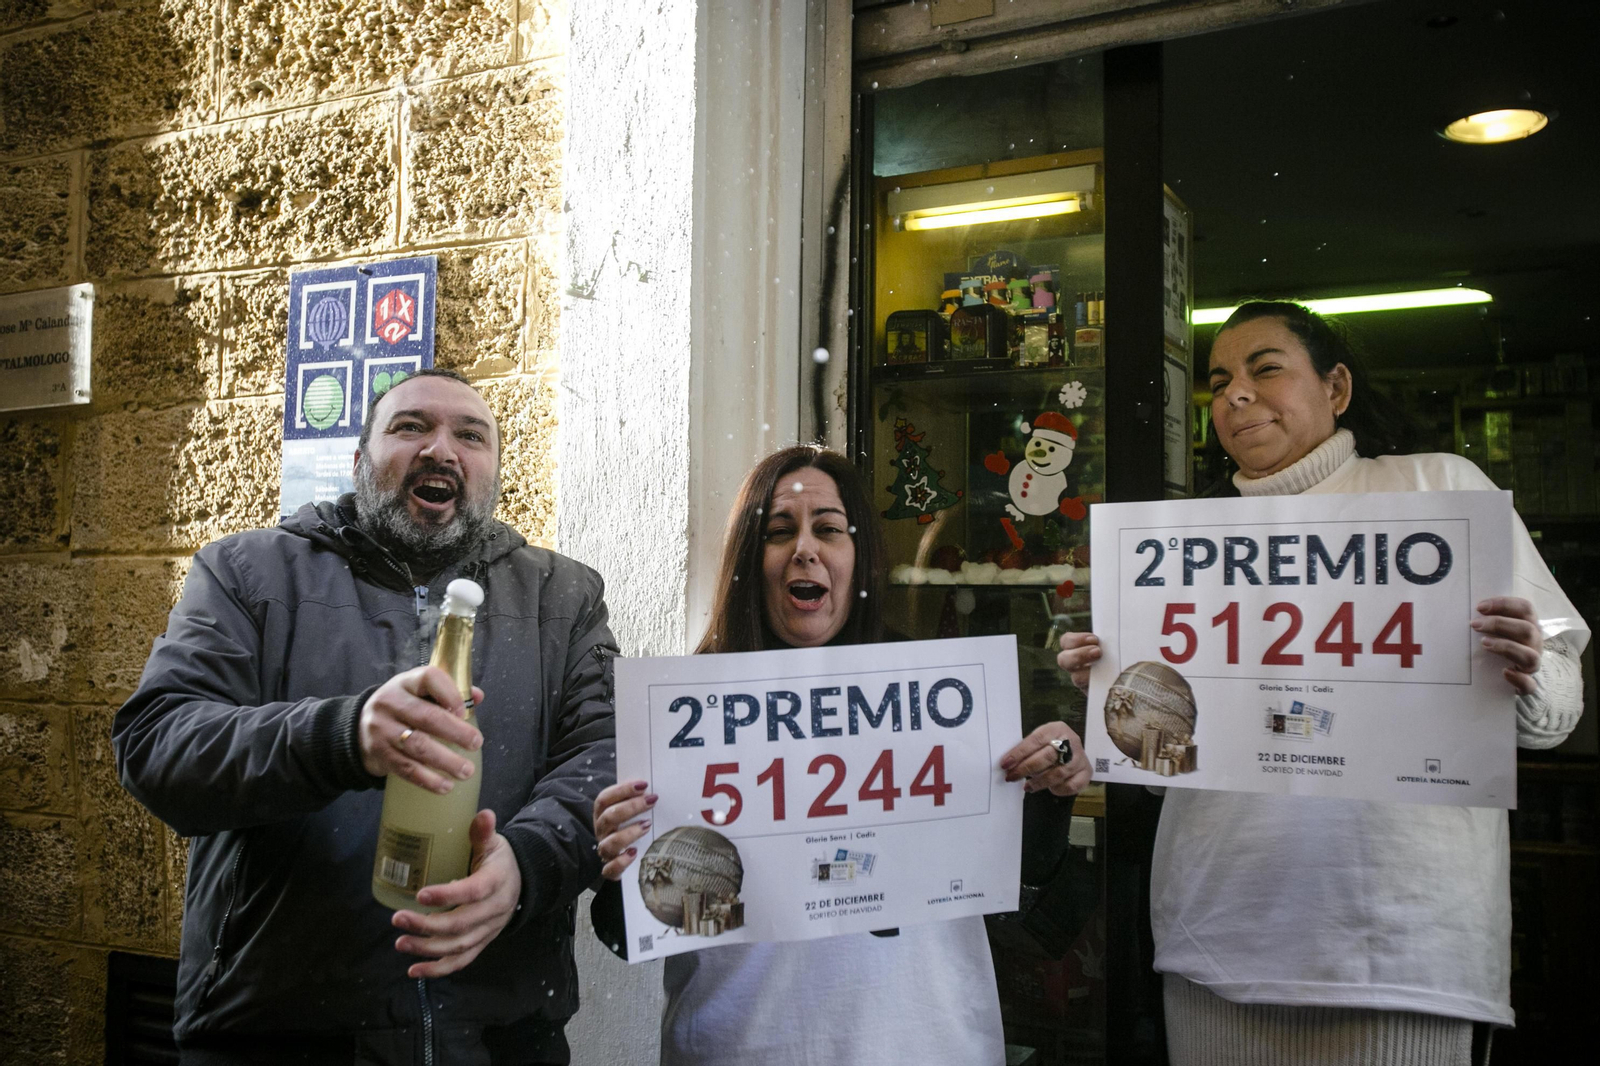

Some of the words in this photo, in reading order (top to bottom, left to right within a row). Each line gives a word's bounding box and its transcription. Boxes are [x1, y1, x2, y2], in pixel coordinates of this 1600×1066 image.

[0, 324, 16, 334] ose
[0, 351, 70, 370] TALMOLOGO
[1159, 601, 1423, 669] 51244
[1258, 752, 1271, 762] 22
[1273, 753, 1287, 763] DE
[1290, 754, 1346, 766] DICIEMBRE
[1262, 765, 1294, 775] SORTEO
[1307, 768, 1343, 777] NAVIDAD
[700, 745, 953, 827] 51244
[1430, 778, 1471, 786] NACIONAL
[805, 901, 817, 911] 22
[819, 899, 832, 909] DE
[834, 892, 885, 907] DICIEMBRE
[953, 892, 985, 901] NACIONAL
[809, 910, 837, 921] SORTEO
[838, 909, 848, 917] DE
[849, 905, 882, 915] NAVIDAD
